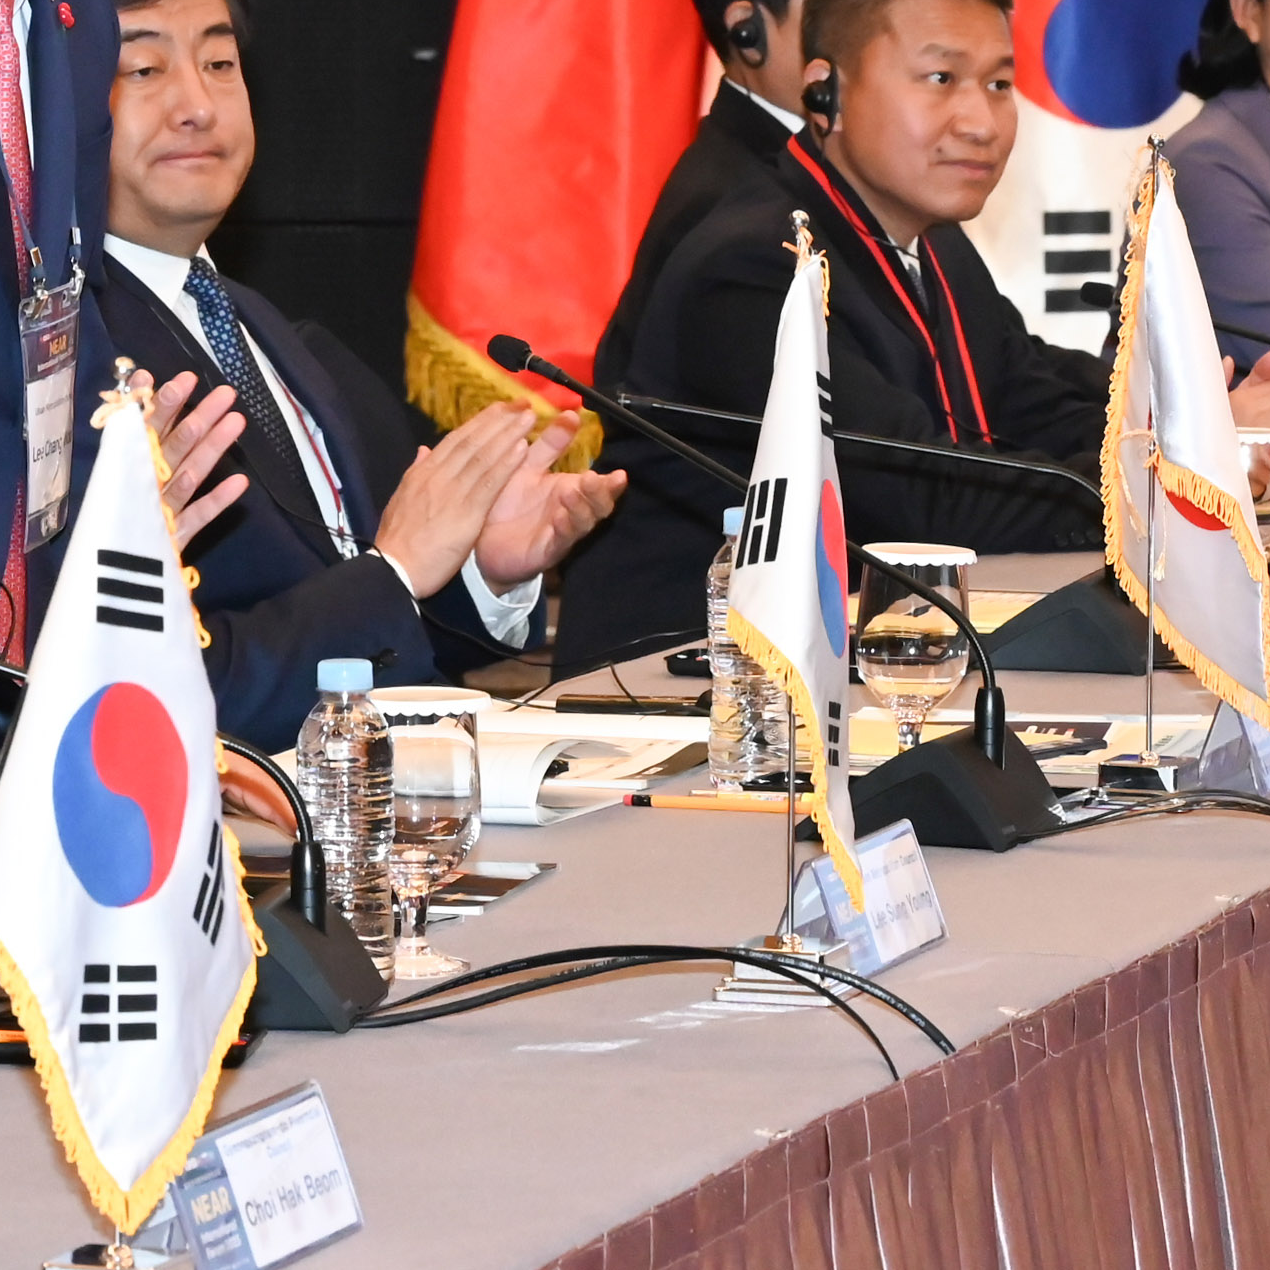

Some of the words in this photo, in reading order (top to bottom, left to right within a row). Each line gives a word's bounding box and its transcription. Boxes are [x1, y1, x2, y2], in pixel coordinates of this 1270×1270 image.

[190, 1185, 233, 1226] NEAR
[244, 1191, 279, 1227] Choi
[279, 1185, 304, 1215] Hak
[303, 1168, 343, 1200] Beom
